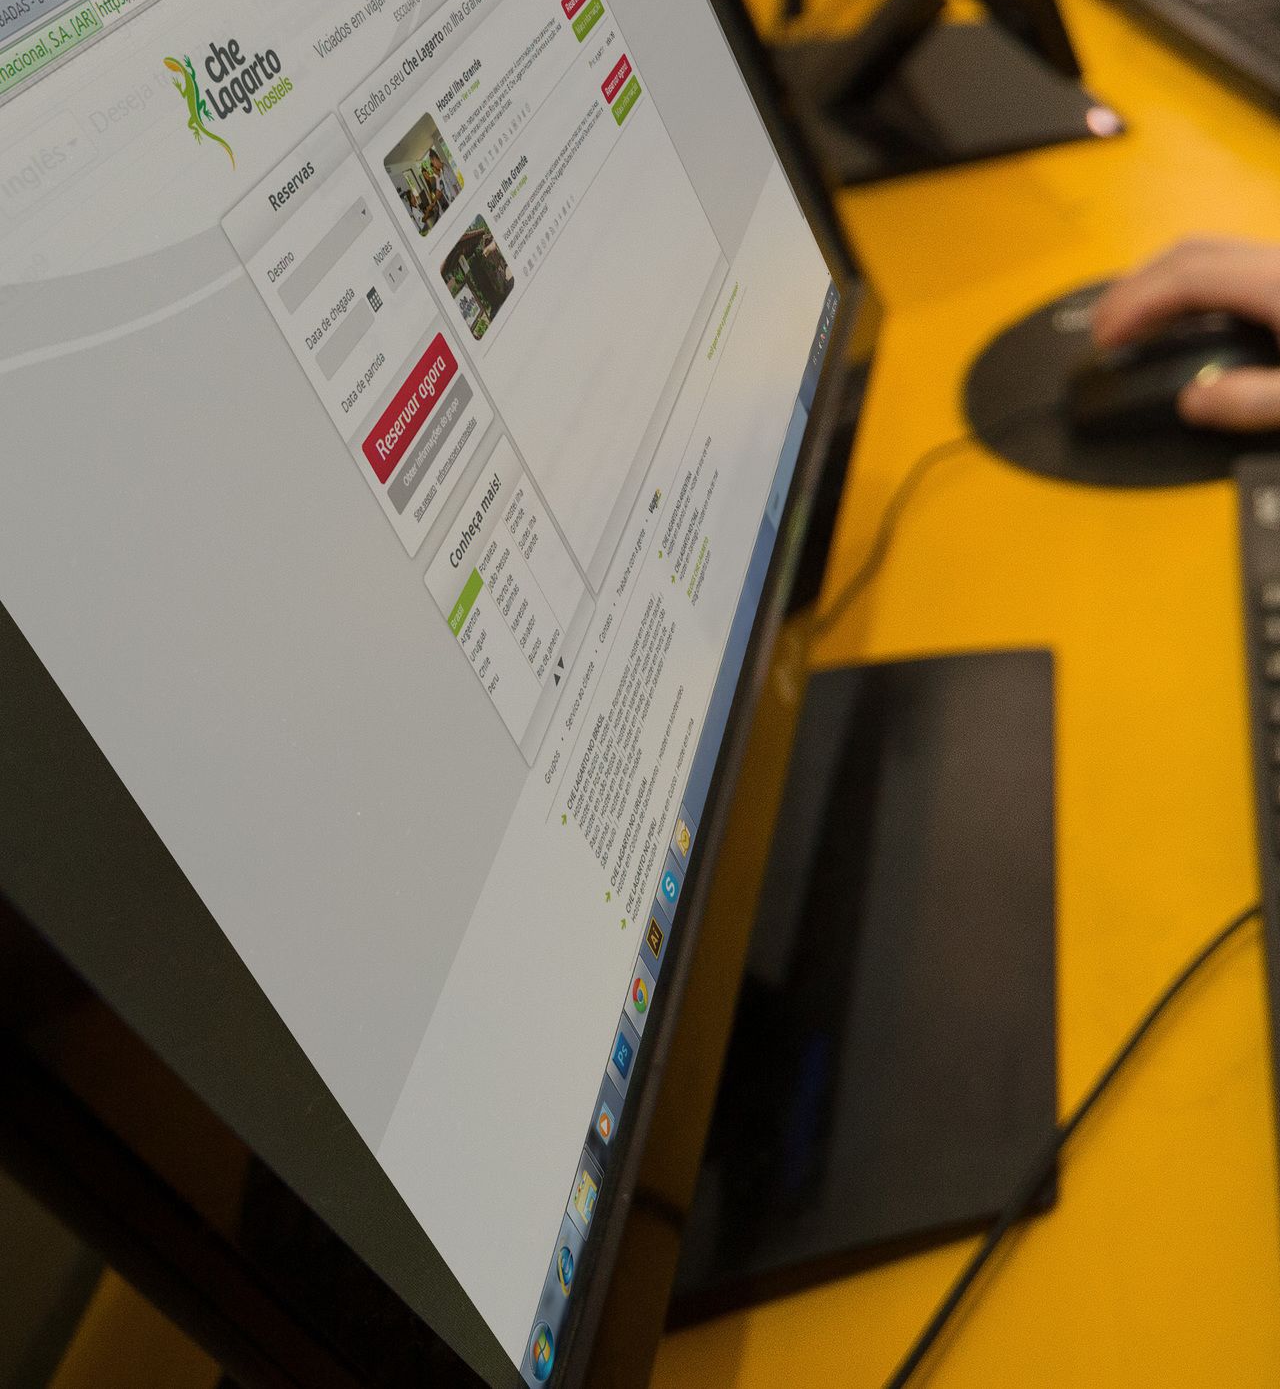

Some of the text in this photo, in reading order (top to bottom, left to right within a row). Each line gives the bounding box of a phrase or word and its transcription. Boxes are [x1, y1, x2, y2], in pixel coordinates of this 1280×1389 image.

[0, 8, 98, 81] nacional, S.A. [AR]
[313, 22, 351, 58] Viciados
[350, 10, 366, 28] em
[201, 33, 246, 85] che
[354, 90, 386, 124] Escolha
[383, 84, 392, 96] o
[389, 70, 405, 90] seu
[402, 56, 419, 75] Che
[415, 31, 444, 62] Lagarto
[442, 22, 453, 36] no
[449, 10, 465, 27] Ilha
[206, 50, 286, 118] lagarto
[254, 77, 293, 115] hostels
[435, 59, 482, 112] Hostel Ilha Grande
[268, 162, 314, 211] Reservas
[487, 155, 528, 212] Suites Ilha Grande
[267, 252, 294, 283] Destino
[373, 241, 392, 266] Noites
[305, 288, 355, 350] Data de chegada
[341, 353, 385, 413] Data de partida
[376, 356, 446, 459] Reservar agora
[403, 463, 418, 486] Obter
[440, 415, 448, 429] do
[445, 397, 459, 421] grupo
[413, 506, 425, 523] Site
[422, 485, 437, 511] seguro
[450, 473, 501, 568] Conheça mais!
[504, 499, 518, 524] Hostel
[510, 508, 525, 534] Grande
[478, 541, 497, 574] Fortaleza
[518, 527, 531, 550] Suites
[524, 533, 538, 560] Grande
[488, 548, 510, 594] João Pessoa
[496, 574, 514, 606] Porto de
[450, 604, 464, 630] Brasil
[460, 607, 480, 646] Argentina
[511, 598, 528, 633] Maresias
[519, 614, 535, 648] Salvador
[599, 613, 613, 643] Contato
[469, 629, 487, 662] Uruguai
[536, 629, 560, 679] Rio de Janeiro
[478, 656, 491, 678] Chile
[487, 673, 499, 695] Peru
[577, 685, 584, 701] ao
[582, 661, 595, 689] cliente
[544, 750, 560, 784] Grupos
[566, 713, 605, 810] CHE LAGARTO NO BRASIL
[610, 777, 647, 887] CHE LAGARTO NO URUGUAI
[625, 817, 657, 913] CHE LAGARTO NO PERU
[617, 1043, 628, 1069] Ps
